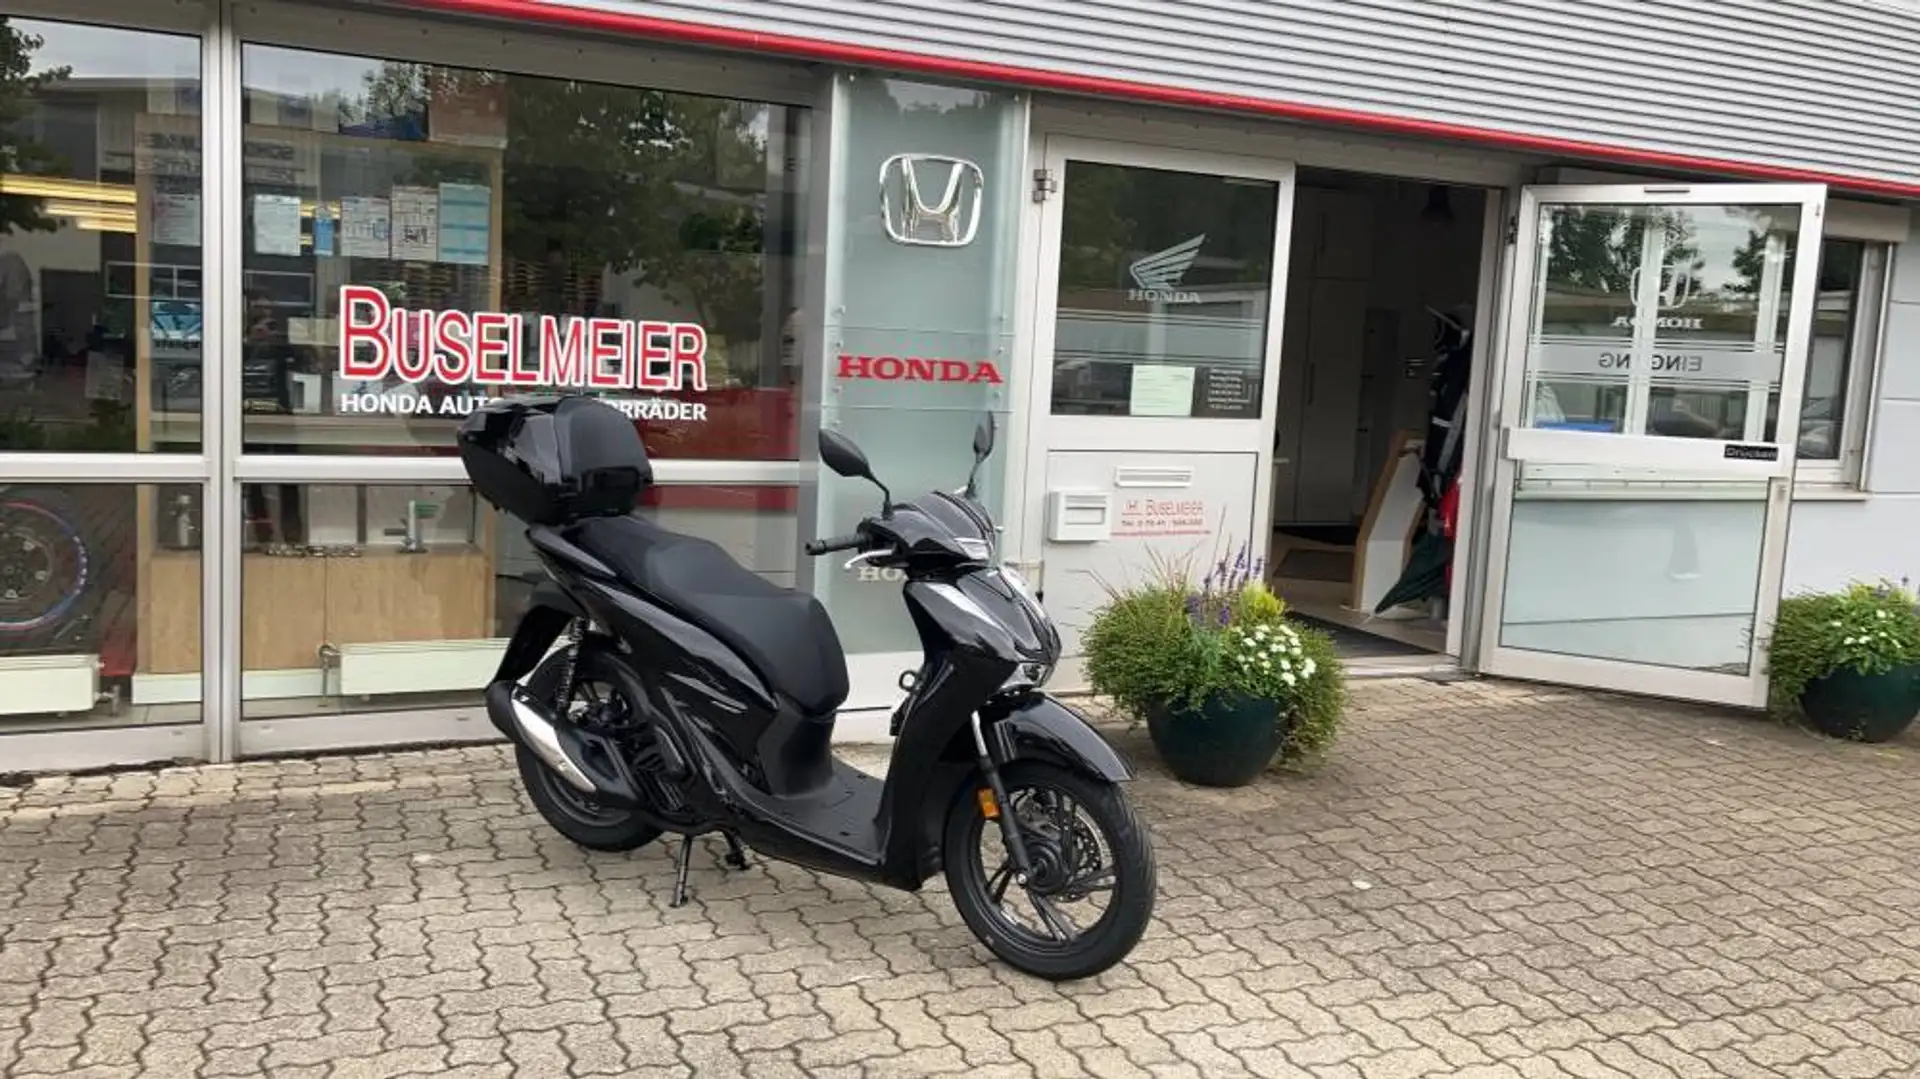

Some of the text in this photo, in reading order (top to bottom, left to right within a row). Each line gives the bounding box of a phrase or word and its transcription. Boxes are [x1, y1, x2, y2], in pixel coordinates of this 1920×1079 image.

[1127, 287, 1203, 304] HONDA
[339, 285, 708, 393] BUSELMEIER
[836, 354, 1004, 385] HONDA
[340, 393, 434, 415] HONDA
